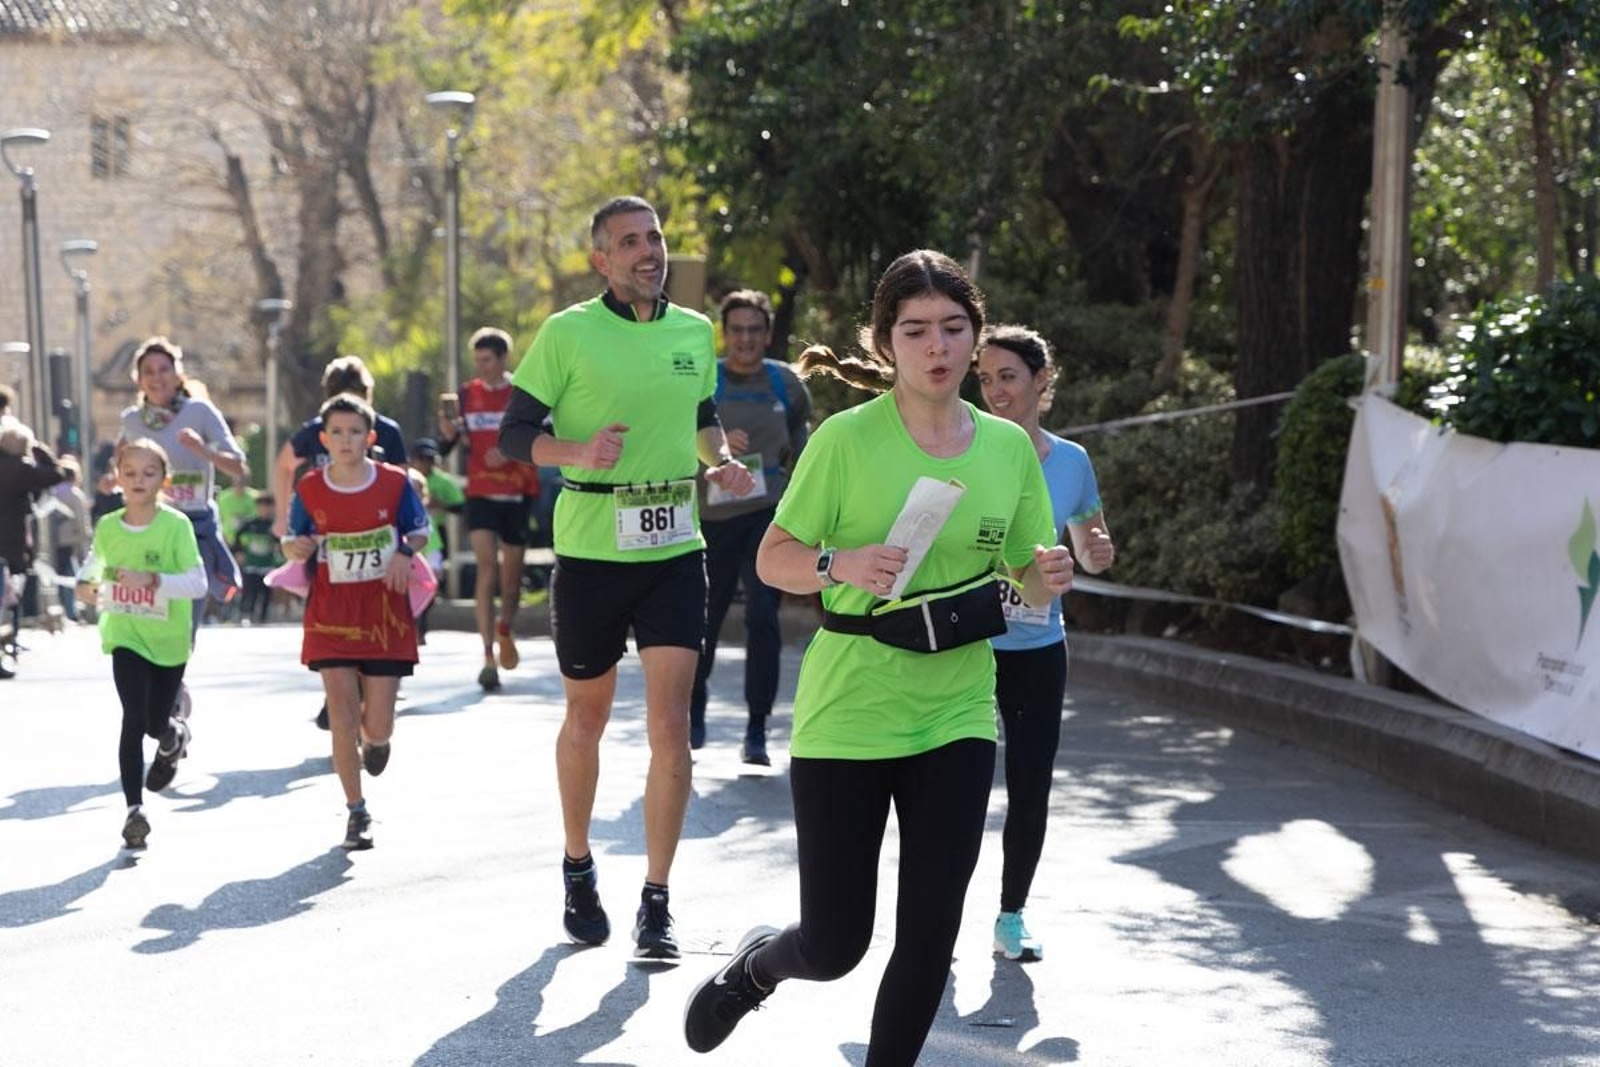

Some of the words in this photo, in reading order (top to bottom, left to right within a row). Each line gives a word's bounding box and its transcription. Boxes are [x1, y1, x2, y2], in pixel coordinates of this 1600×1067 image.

[640, 505, 675, 532] 861
[344, 549, 382, 570] 773
[112, 584, 155, 608] 1004
[996, 580, 1032, 609] 86
